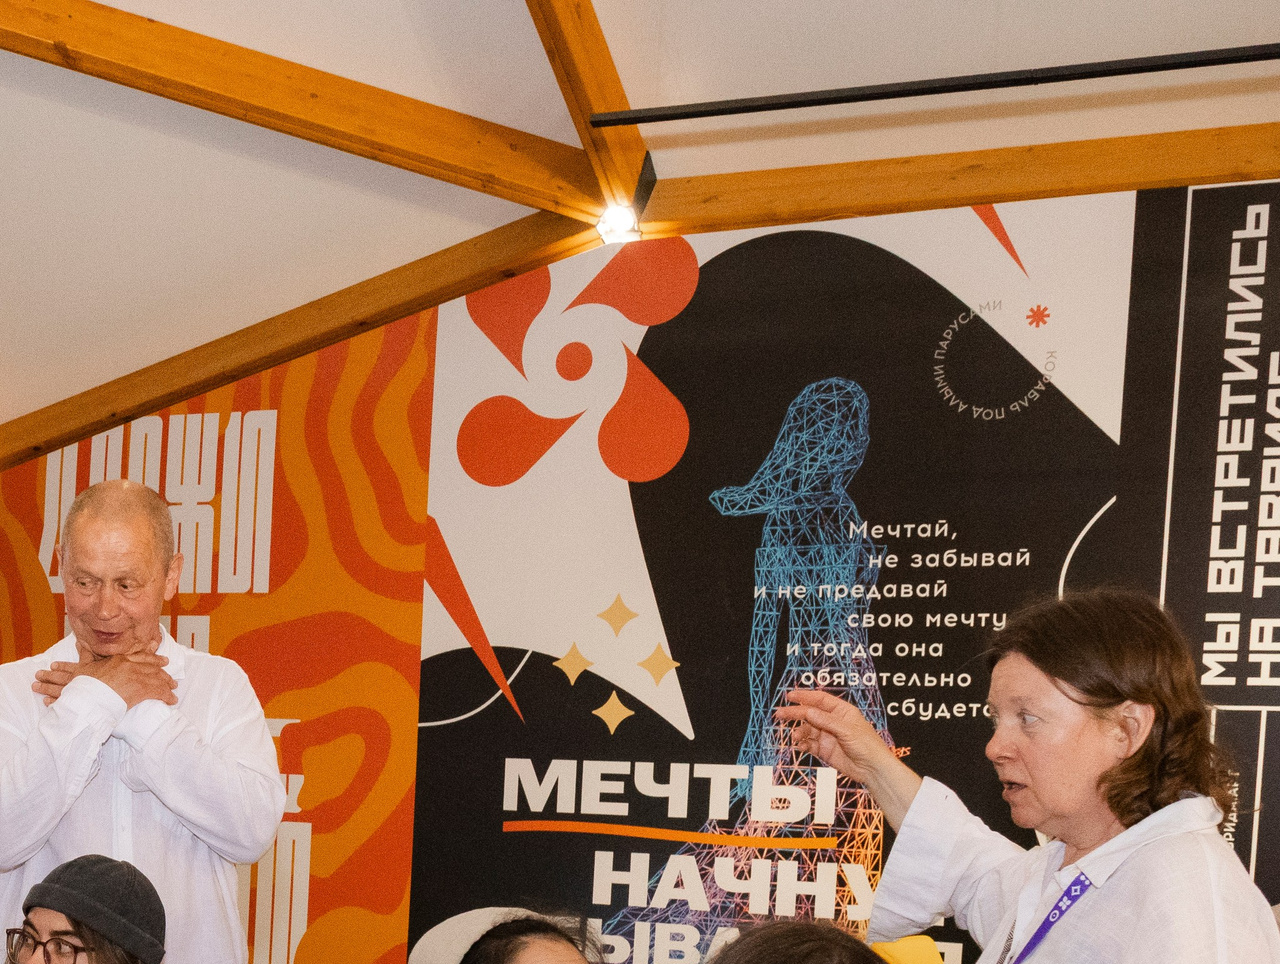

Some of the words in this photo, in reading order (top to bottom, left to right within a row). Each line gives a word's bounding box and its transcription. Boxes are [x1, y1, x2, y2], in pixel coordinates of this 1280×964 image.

[933, 299, 1003, 360] ПАРУСАМИ
[933, 364, 968, 413] АЛЫМИ
[1009, 350, 1058, 413] КОРАБЛЬ
[1207, 204, 1270, 593] ВСТРЕТИЛИСЬ
[971, 405, 1005, 421] ПОД
[848, 520, 958, 540] Мечтай,
[869, 552, 899, 569] не
[910, 549, 1031, 568] забывай
[753, 585, 767, 599] и
[778, 584, 807, 599] не
[818, 580, 948, 602] предавай
[847, 612, 914, 628] свою
[926, 612, 1008, 632] мечту
[786, 643, 799, 657] и
[810, 641, 884, 660] тогда
[895, 642, 944, 657] она
[1200, 613, 1241, 686] МЫ
[801, 668, 972, 688] обязательно
[887, 698, 992, 721] сбудетс
[502, 757, 837, 826] МЕЧТЫ
[592, 850, 876, 920] НАЧНУ
